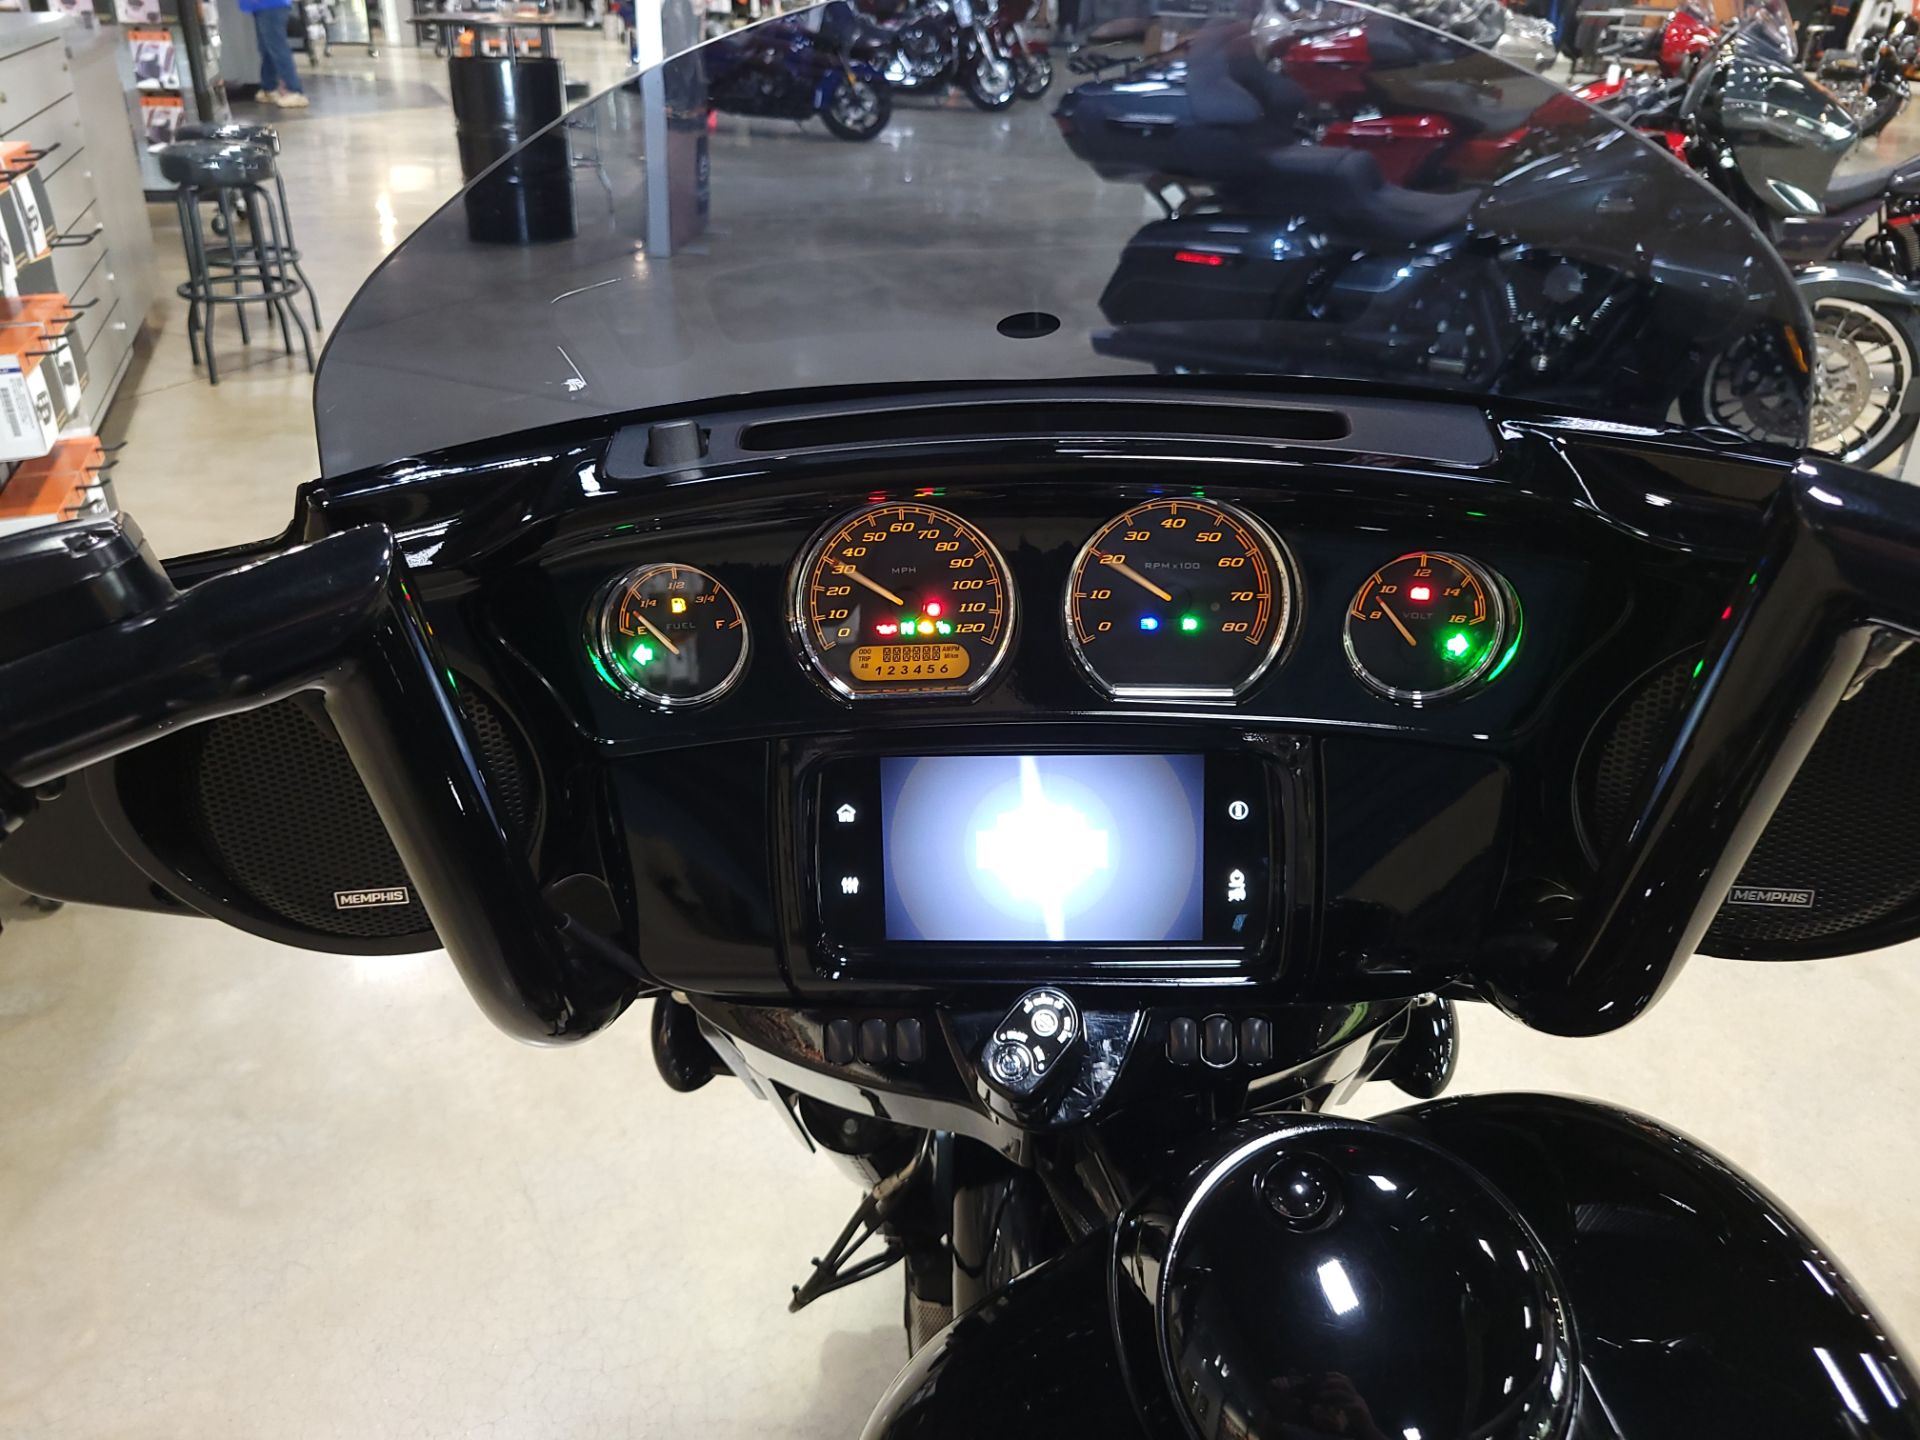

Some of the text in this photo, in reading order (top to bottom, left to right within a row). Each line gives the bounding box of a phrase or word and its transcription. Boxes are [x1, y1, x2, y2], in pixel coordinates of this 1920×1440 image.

[889, 522, 915, 533] 60
[1160, 518, 1187, 529] 40
[862, 532, 887, 542] 50
[917, 529, 940, 540] 70
[1123, 530, 1150, 542] 30
[1195, 532, 1222, 543] 50
[841, 547, 867, 557] 40
[934, 541, 960, 552] 80
[948, 558, 974, 569] 90
[1099, 554, 1126, 565] 20
[1217, 556, 1245, 568] 60
[831, 564, 856, 574] 30
[1413, 568, 1432, 577] 12
[951, 580, 983, 590] 100
[1379, 585, 1398, 594] 10
[826, 586, 850, 596] 20
[1089, 589, 1111, 600] 10
[1230, 591, 1254, 602] 70
[1443, 588, 1461, 597] 14
[695, 594, 715, 604] 3/4
[959, 602, 986, 613] 110
[828, 609, 849, 620] 10
[1369, 611, 1382, 620] 8
[1402, 612, 1433, 620] VOLT
[665, 621, 697, 631] FUEL
[715, 619, 726, 630] F
[955, 623, 986, 634] 120
[1098, 621, 1112, 632] 0
[1221, 622, 1248, 633] 80
[637, 626, 648, 635] E
[838, 627, 851, 638] 0
[340, 891, 404, 905] MEMPHIS
[1733, 890, 1809, 904] MEMPHIS
